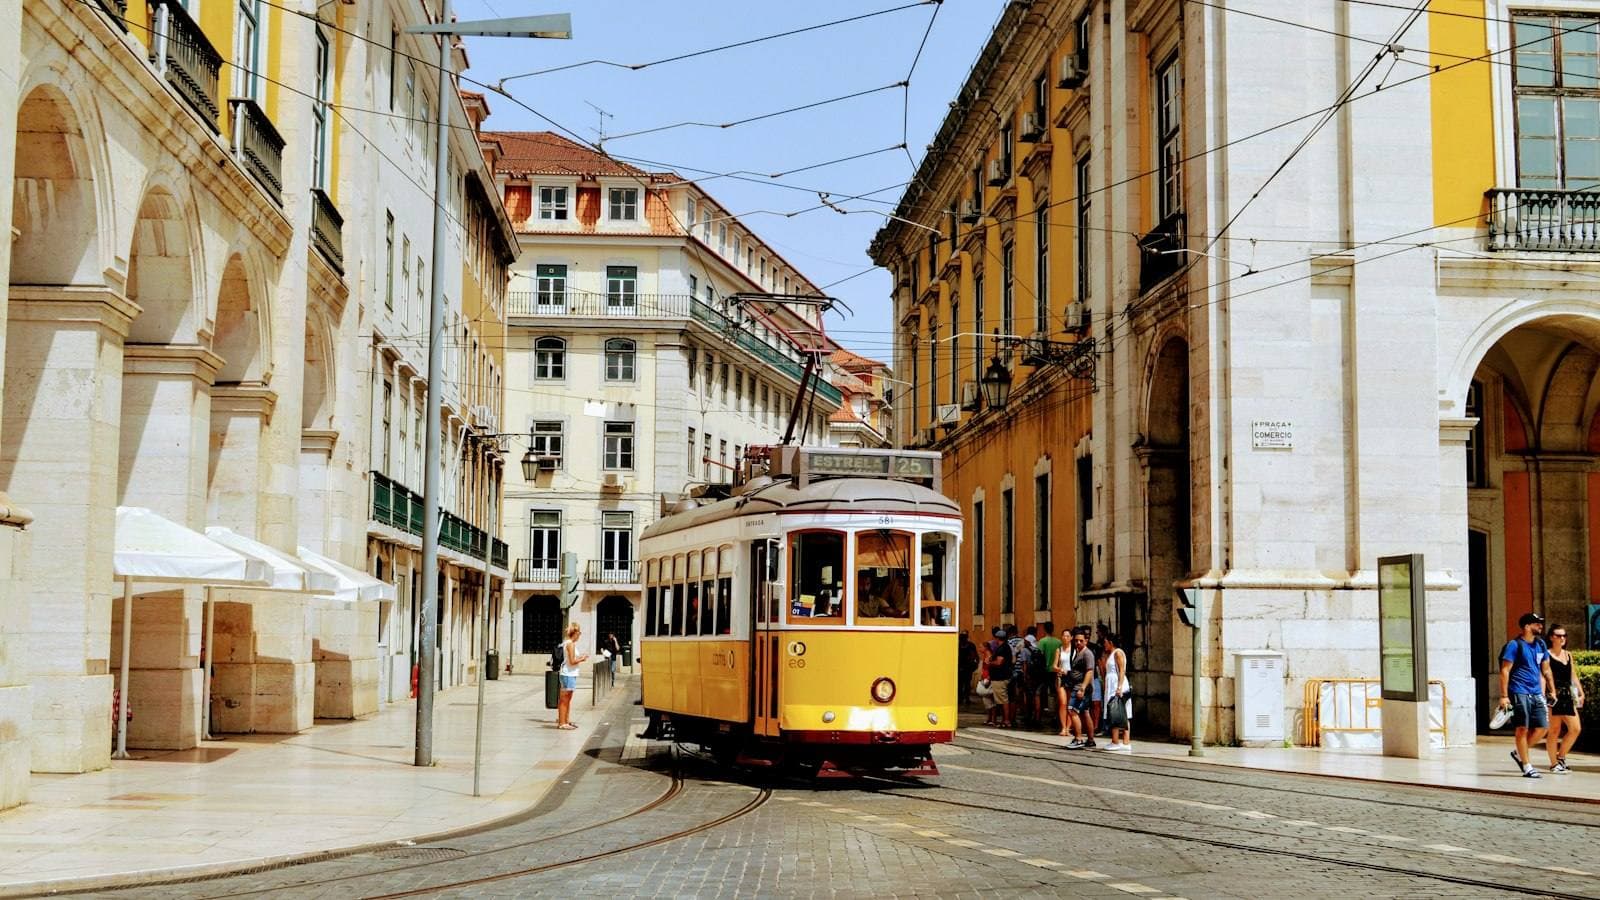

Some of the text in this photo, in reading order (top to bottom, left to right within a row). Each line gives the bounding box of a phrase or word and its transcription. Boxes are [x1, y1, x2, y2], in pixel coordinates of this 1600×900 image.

[1259, 421, 1287, 429] PRAÇA
[1254, 431, 1292, 439] COMERCIO
[813, 455, 883, 468] ESTRELA
[898, 457, 922, 473] 25
[879, 516, 893, 525] 581
